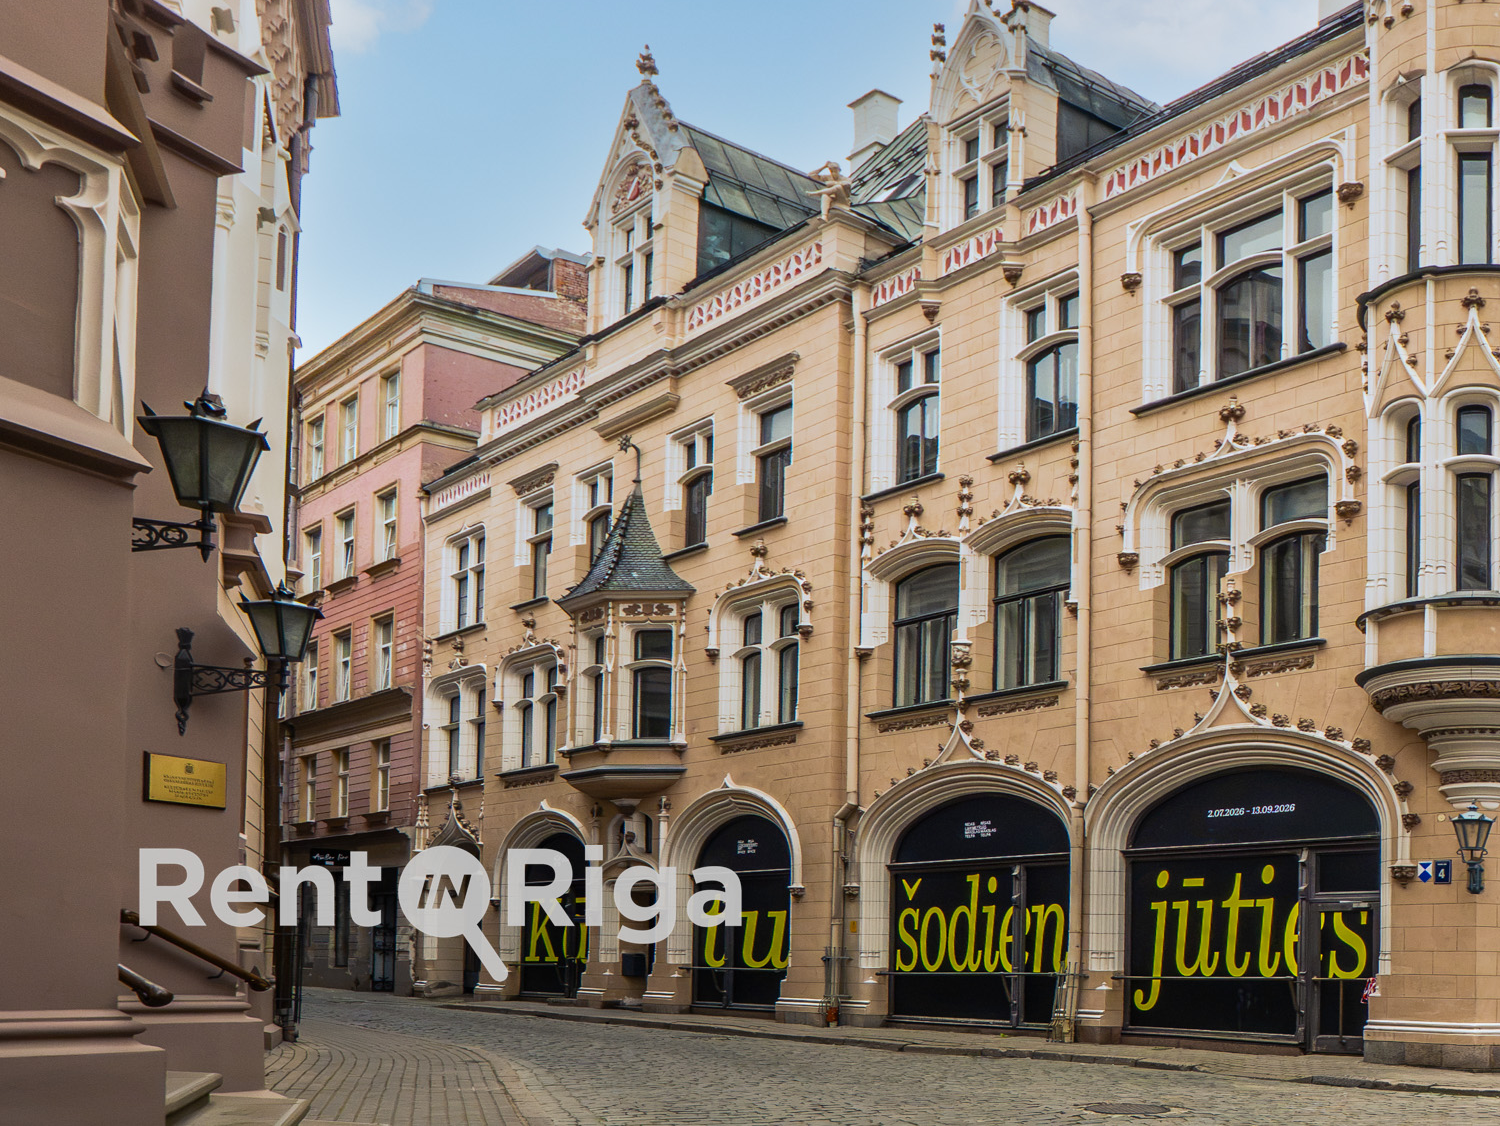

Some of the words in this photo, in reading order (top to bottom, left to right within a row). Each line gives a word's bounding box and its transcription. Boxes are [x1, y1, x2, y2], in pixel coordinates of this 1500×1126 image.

[1207, 808, 1245, 818] 2.07.2026
[1251, 804, 1296, 814] 13.09.2026
[1438, 868, 1446, 879] 4
[896, 874, 1068, 973] šodien
[1134, 865, 1368, 1011] jūties
